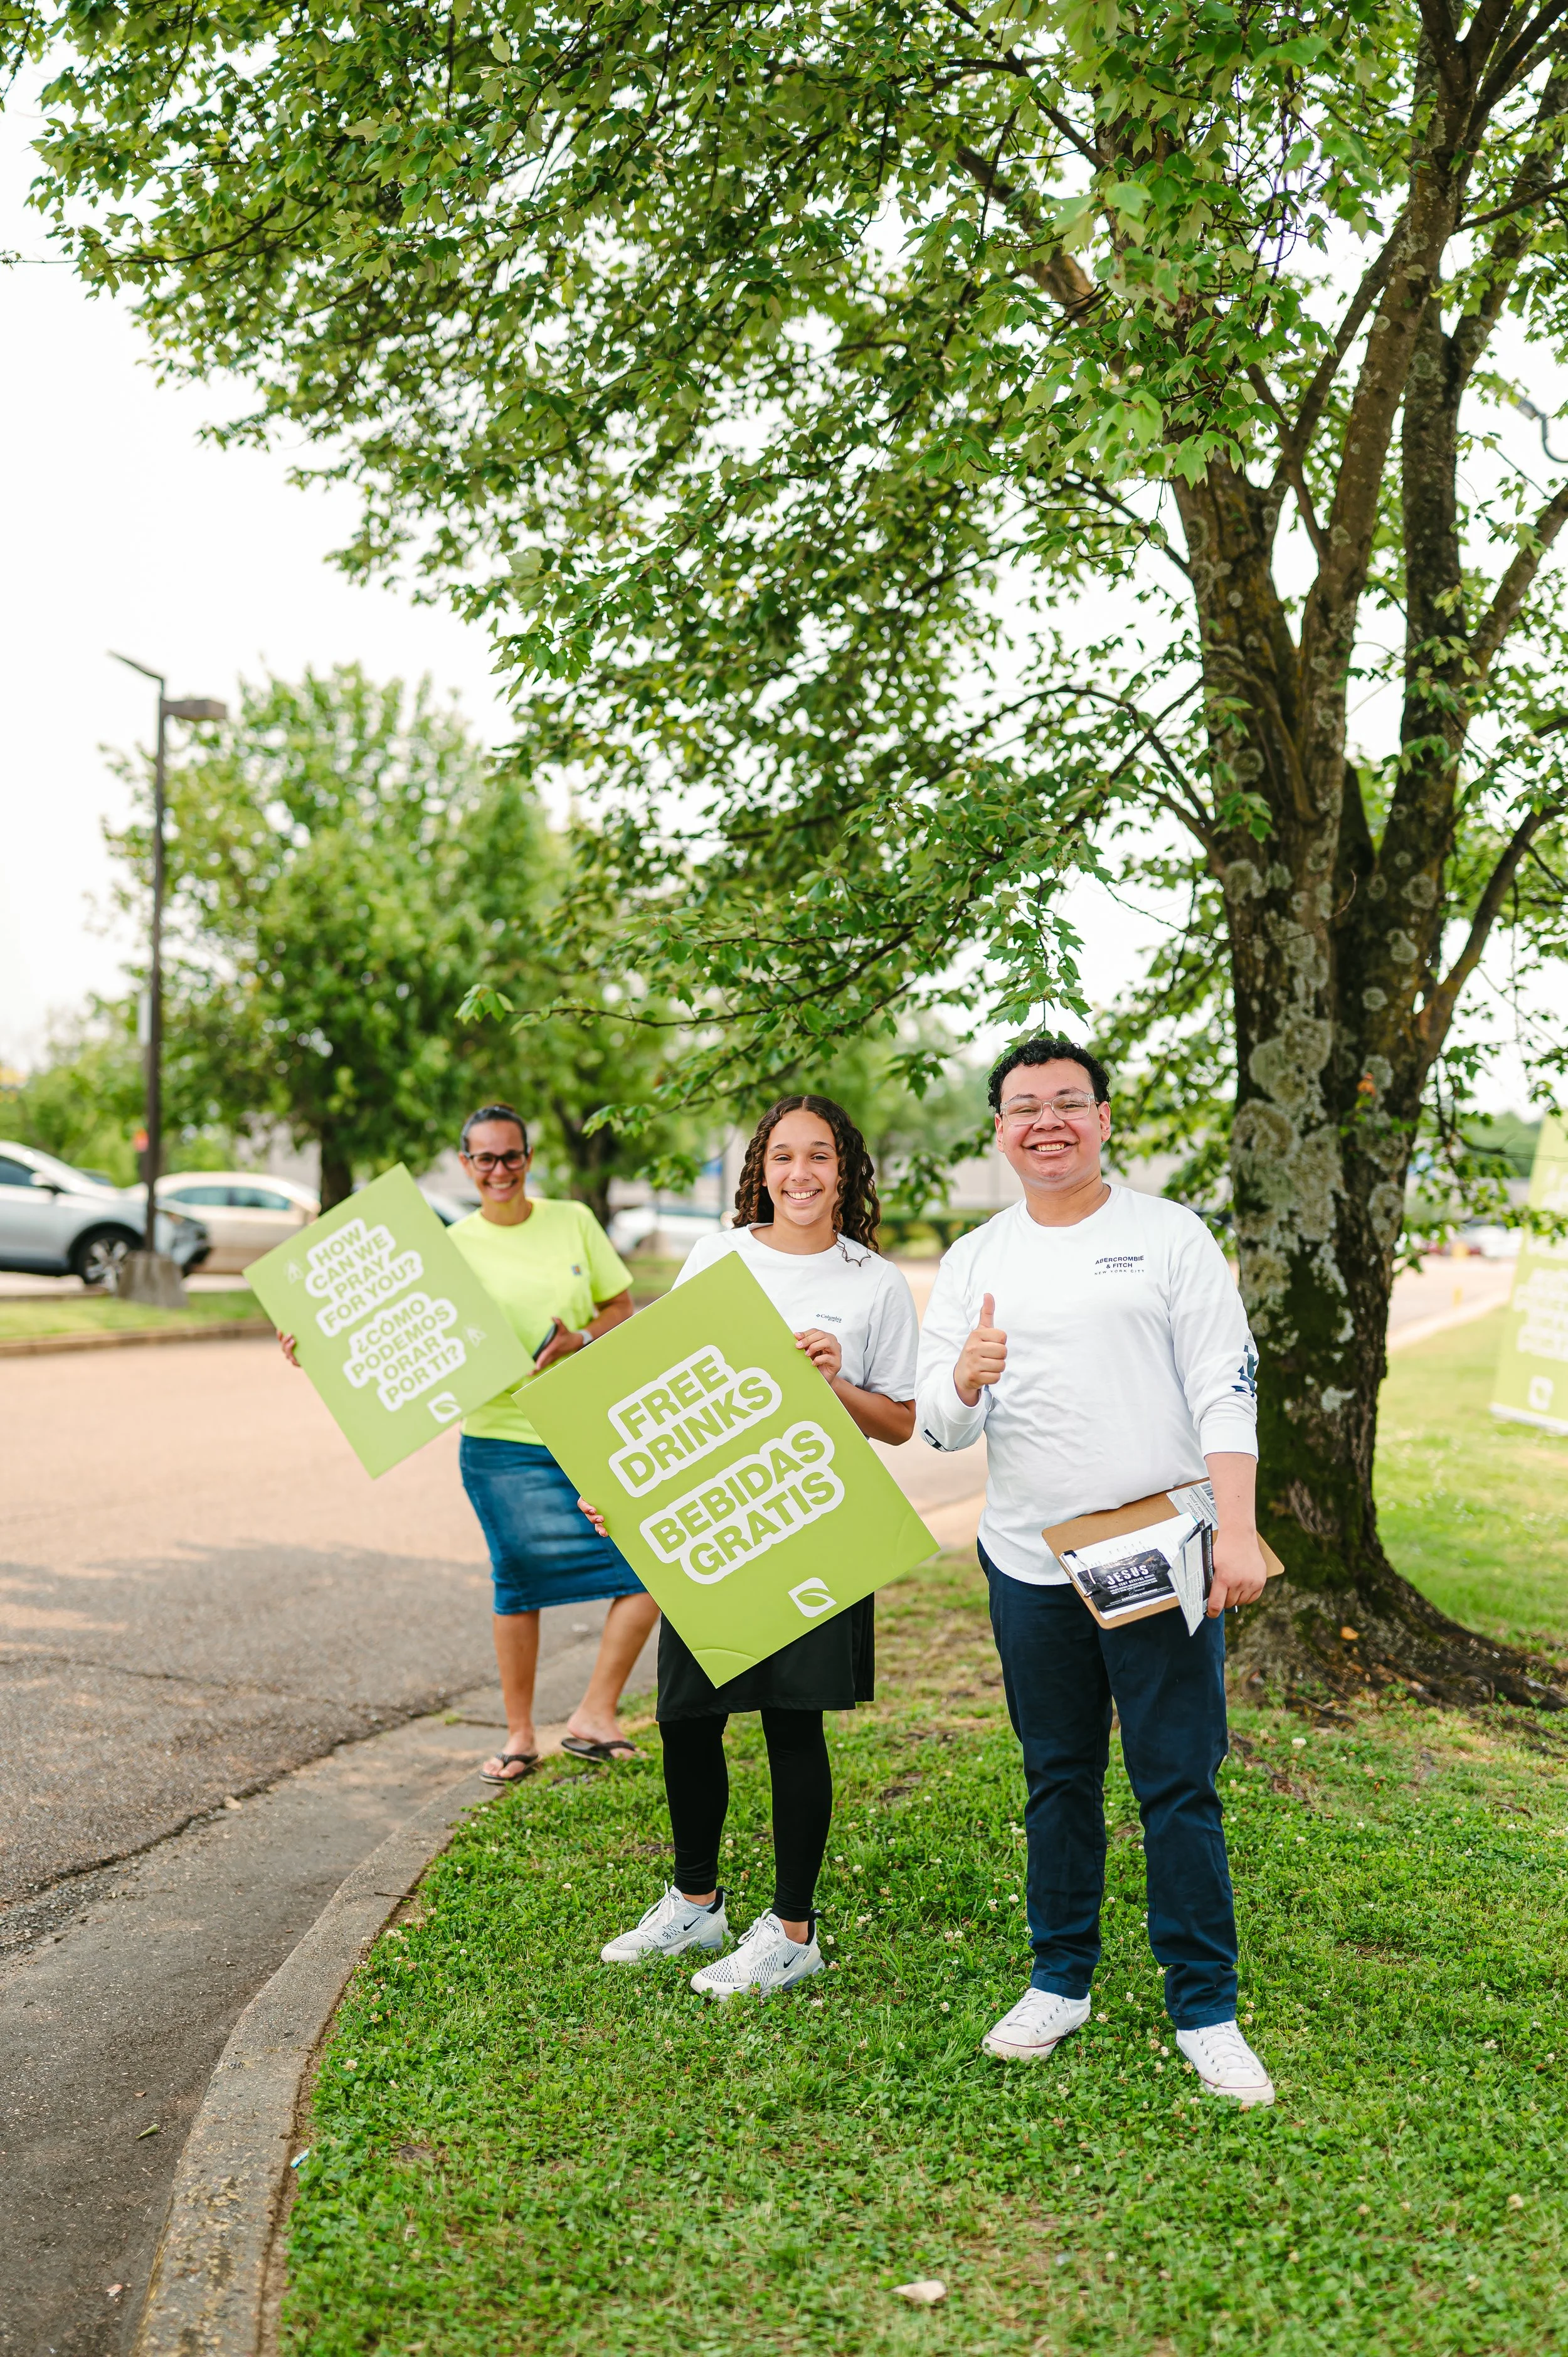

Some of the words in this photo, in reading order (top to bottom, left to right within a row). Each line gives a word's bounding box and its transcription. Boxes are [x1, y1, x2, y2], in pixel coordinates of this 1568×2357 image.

[312, 1255, 354, 1290] CAN
[353, 1233, 387, 1260] WE
[314, 1226, 361, 1267] HOW
[1095, 1255, 1144, 1265] ABERCROMBIE
[324, 1294, 366, 1328] FOR
[364, 1258, 413, 1297] YOU?
[334, 1255, 384, 1299] PRAY
[351, 1305, 449, 1380] PODEMOS
[357, 1299, 425, 1354] ¿CÓMO
[383, 1336, 440, 1380] ORAR
[384, 1366, 430, 1403] POR
[618, 1355, 728, 1439] FREE
[619, 1377, 771, 1487] DRINKS
[650, 1430, 824, 1553] BEBIDAS
[689, 1472, 834, 1575] GRATIS
[1106, 1565, 1149, 1585] JESUS
